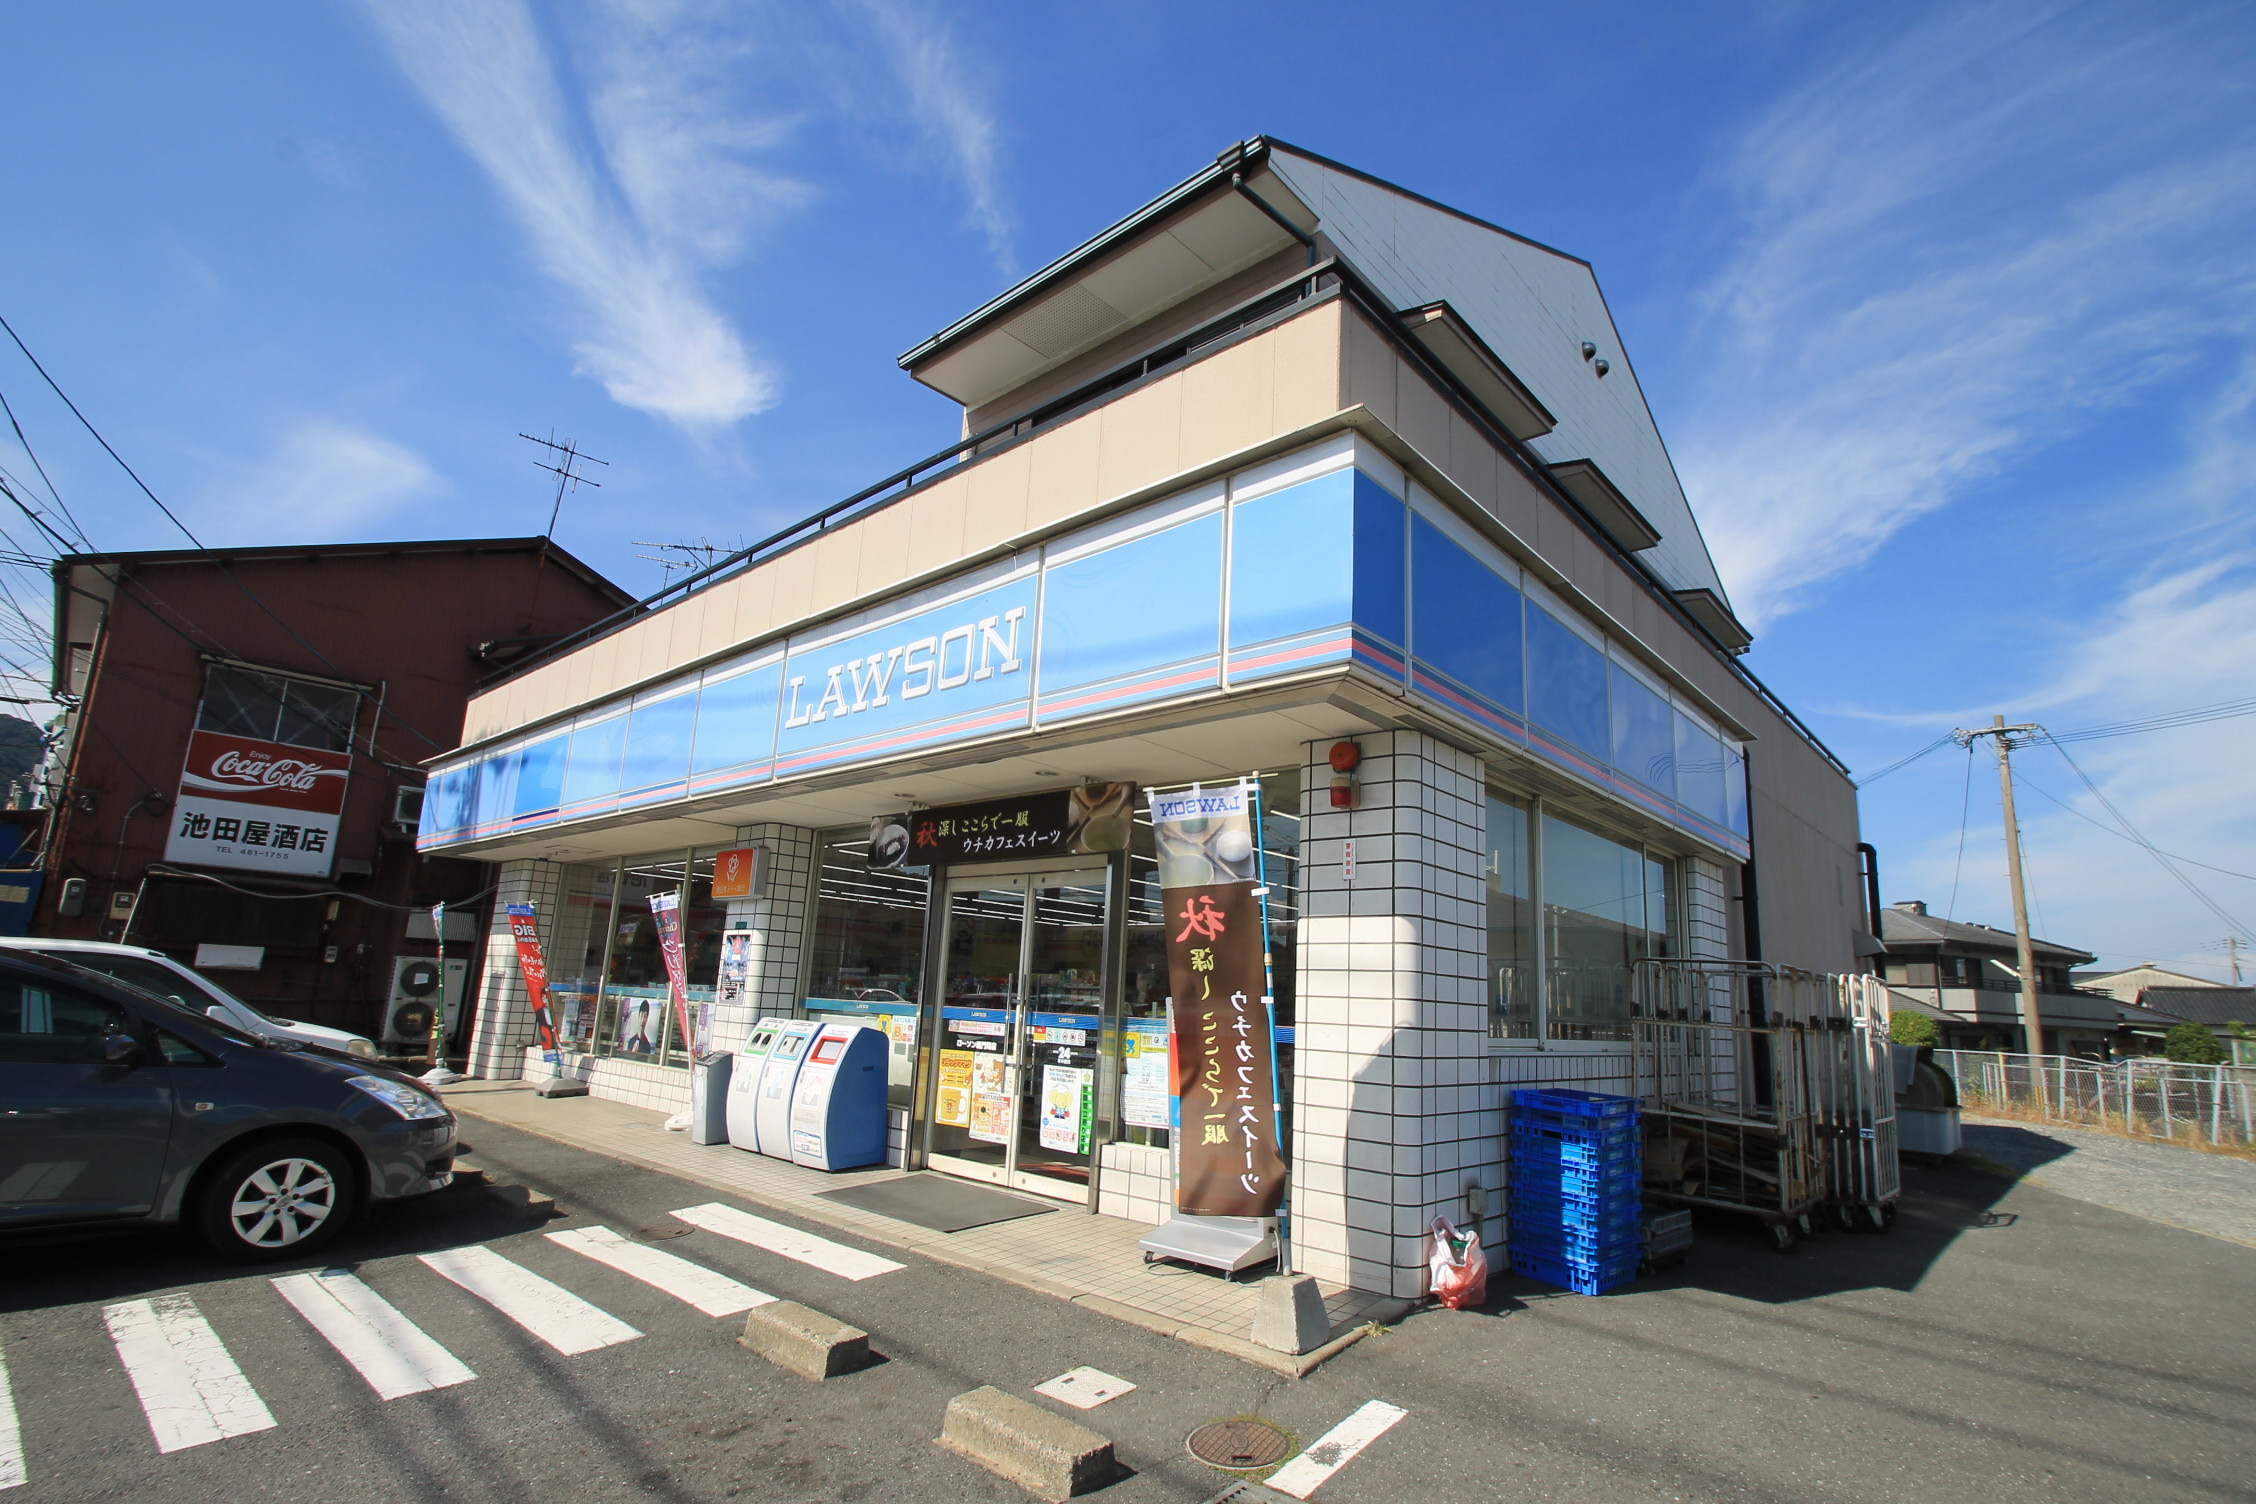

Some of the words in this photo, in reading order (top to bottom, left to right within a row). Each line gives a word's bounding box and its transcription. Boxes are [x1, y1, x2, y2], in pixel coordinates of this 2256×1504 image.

[785, 606, 1026, 729] LAWSON
[249, 750, 272, 760] Enjoy
[211, 750, 322, 790] Coca-Cola
[180, 811, 329, 854] 池田屋酒店
[963, 829, 1061, 854] ウチカフェスイーツ
[216, 846, 233, 854] TEL
[240, 848, 289, 860] 481-1755
[1058, 1046, 1071, 1059] 24
